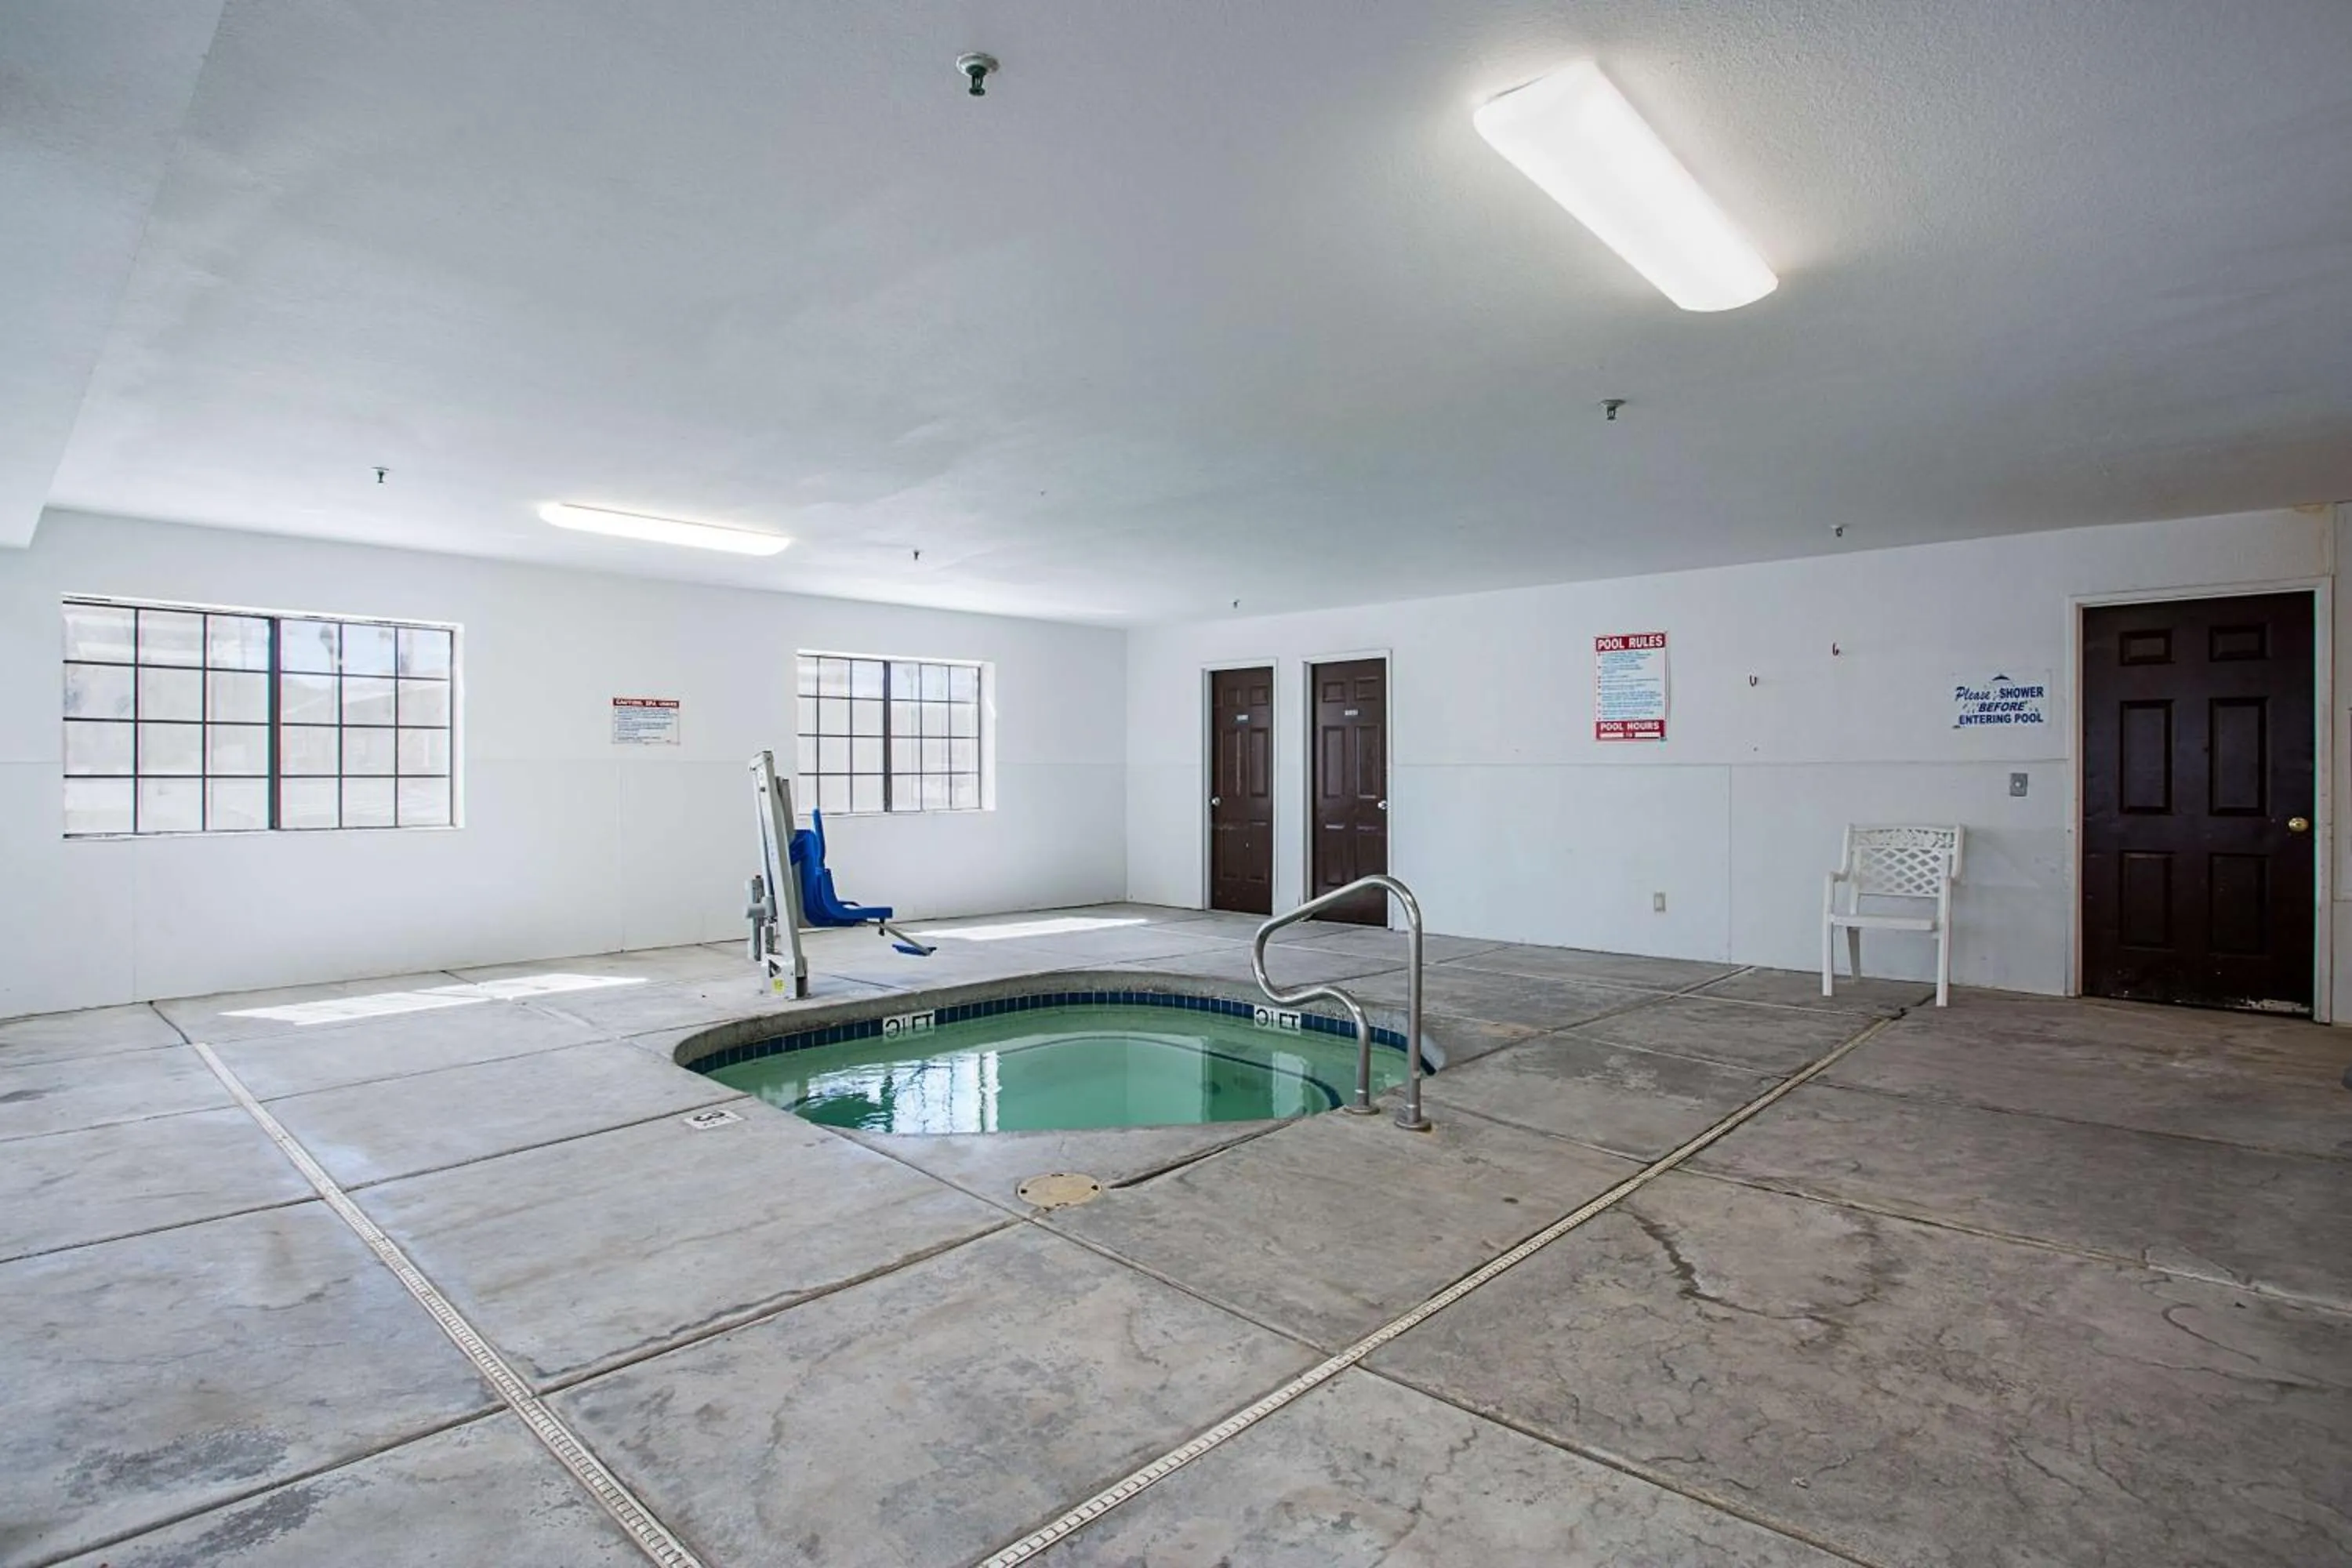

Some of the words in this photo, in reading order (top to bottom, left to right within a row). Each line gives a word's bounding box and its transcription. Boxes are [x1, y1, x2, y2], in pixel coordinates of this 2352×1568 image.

[1597, 638, 1624, 650] POOL
[1628, 636, 1663, 648] RULES
[1955, 686, 1991, 701] Please
[1999, 686, 2044, 699] SHOWER
[1978, 702, 2026, 712] BEFORE
[1959, 713, 2011, 724] ENTERING
[2014, 713, 2044, 723] POOL
[1600, 722, 1624, 731] POOL
[1627, 721, 1660, 730] HOURS
